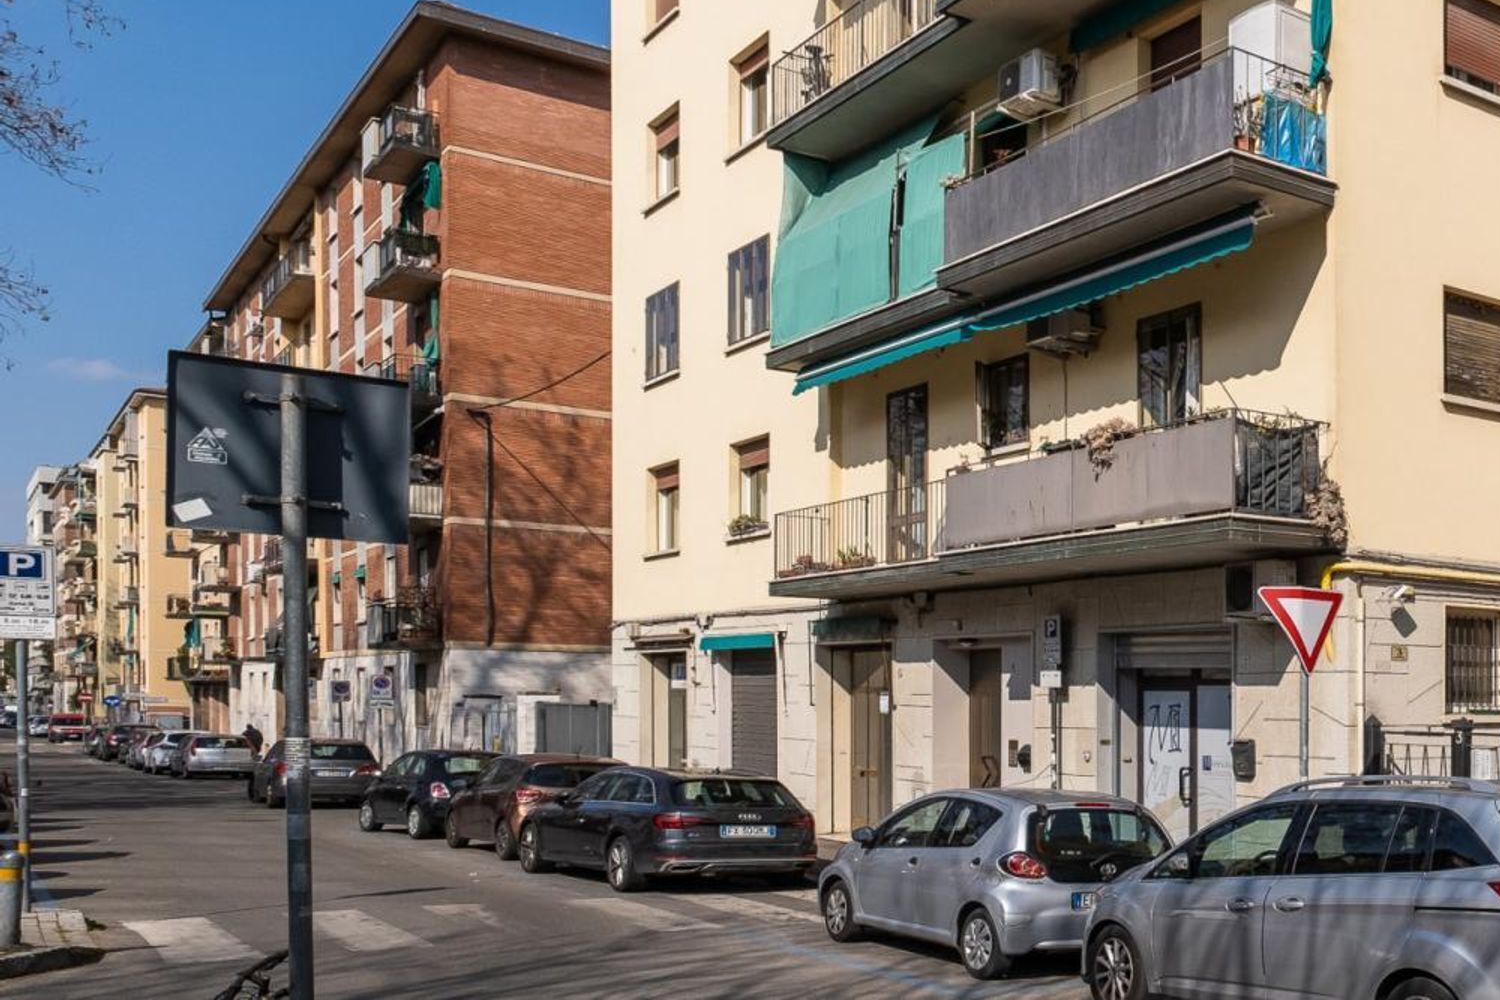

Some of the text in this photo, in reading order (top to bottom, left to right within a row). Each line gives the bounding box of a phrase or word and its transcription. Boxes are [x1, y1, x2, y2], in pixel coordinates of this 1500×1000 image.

[8, 552, 36, 576] P
[1047, 620, 1056, 637] P
[1455, 730, 1463, 744] 3
